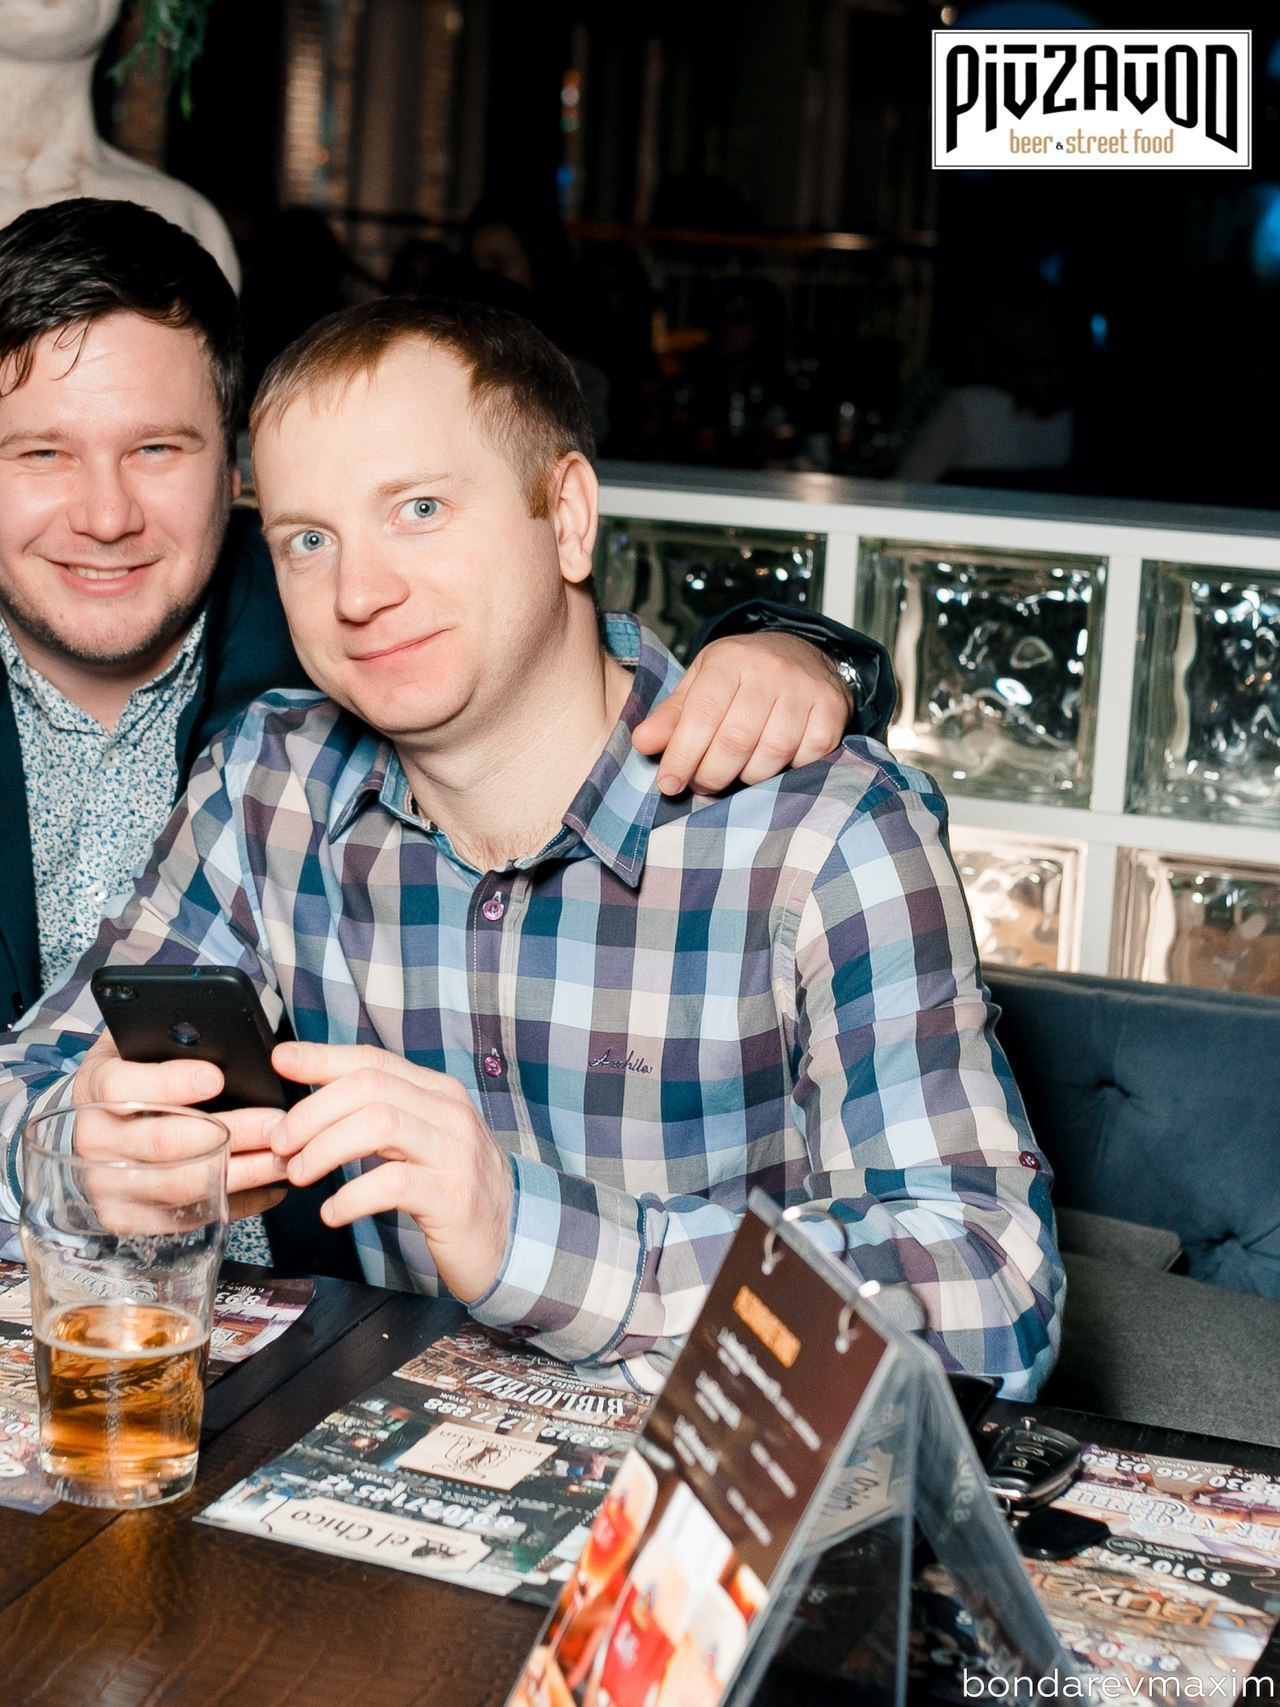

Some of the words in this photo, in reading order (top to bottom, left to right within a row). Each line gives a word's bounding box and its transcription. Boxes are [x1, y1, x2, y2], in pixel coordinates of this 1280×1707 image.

[242, 1295, 261, 1307] 8
[466, 1369, 625, 1417] BIBLIOTEKA
[423, 1398, 472, 1418] 888
[470, 1411, 520, 1430] 777
[540, 1425, 587, 1444] 919
[590, 1435, 610, 1449] 8
[1155, 1467, 1204, 1484] 766
[1208, 1475, 1258, 1493] 930
[1263, 1483, 1280, 1496] 8
[291, 1509, 374, 1543] Chico
[493, 1515, 516, 1529] 8
[376, 1533, 411, 1548] el
[1152, 1559, 1207, 1582] 910
[1209, 1571, 1231, 1587] 8
